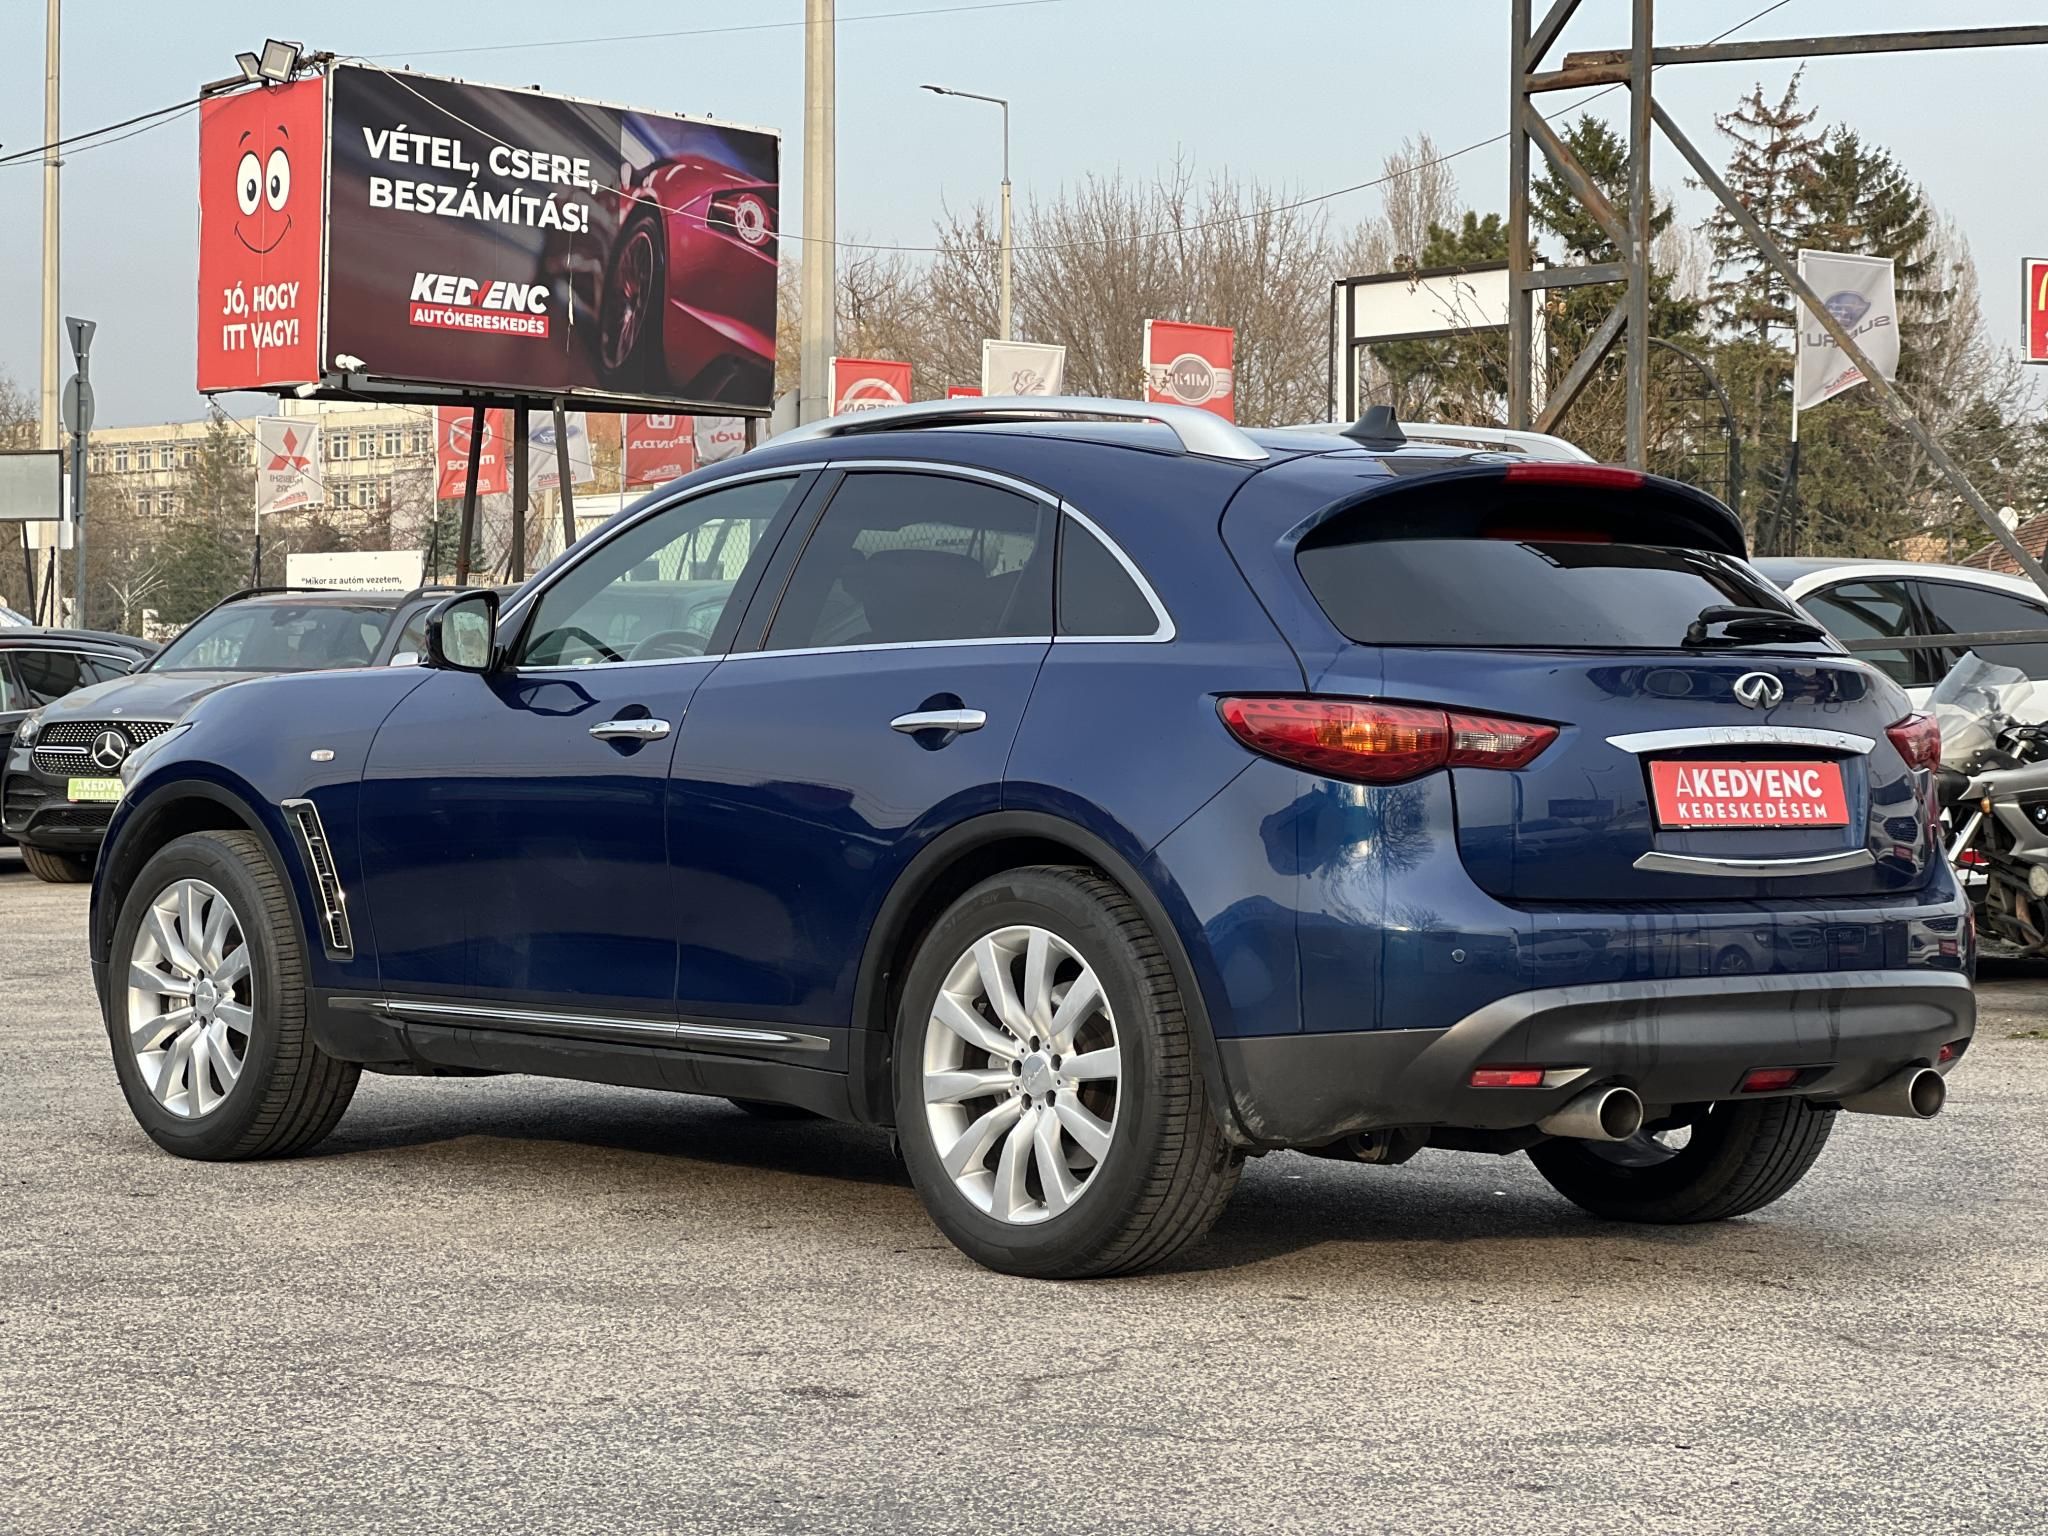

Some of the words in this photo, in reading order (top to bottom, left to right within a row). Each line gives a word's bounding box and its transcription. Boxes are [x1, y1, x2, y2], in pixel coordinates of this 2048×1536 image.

[362, 124, 480, 178] VÉTEL,
[488, 146, 598, 195] CSERE,
[369, 176, 589, 233] BESZÁMÍTÁS!
[223, 281, 249, 318] JÓ,
[253, 281, 299, 312] HOGY
[410, 272, 550, 314] KEDVENC
[223, 323, 248, 351] ITT
[250, 318, 299, 348] VAGY!
[414, 309, 545, 334] AUTÓKERESKEDÉS
[339, 576, 365, 585] autóm
[366, 575, 403, 584] vezetem,
[76, 780, 123, 791] AKEDVE
[1678, 799, 1828, 819] KERESKEDÉSEM
